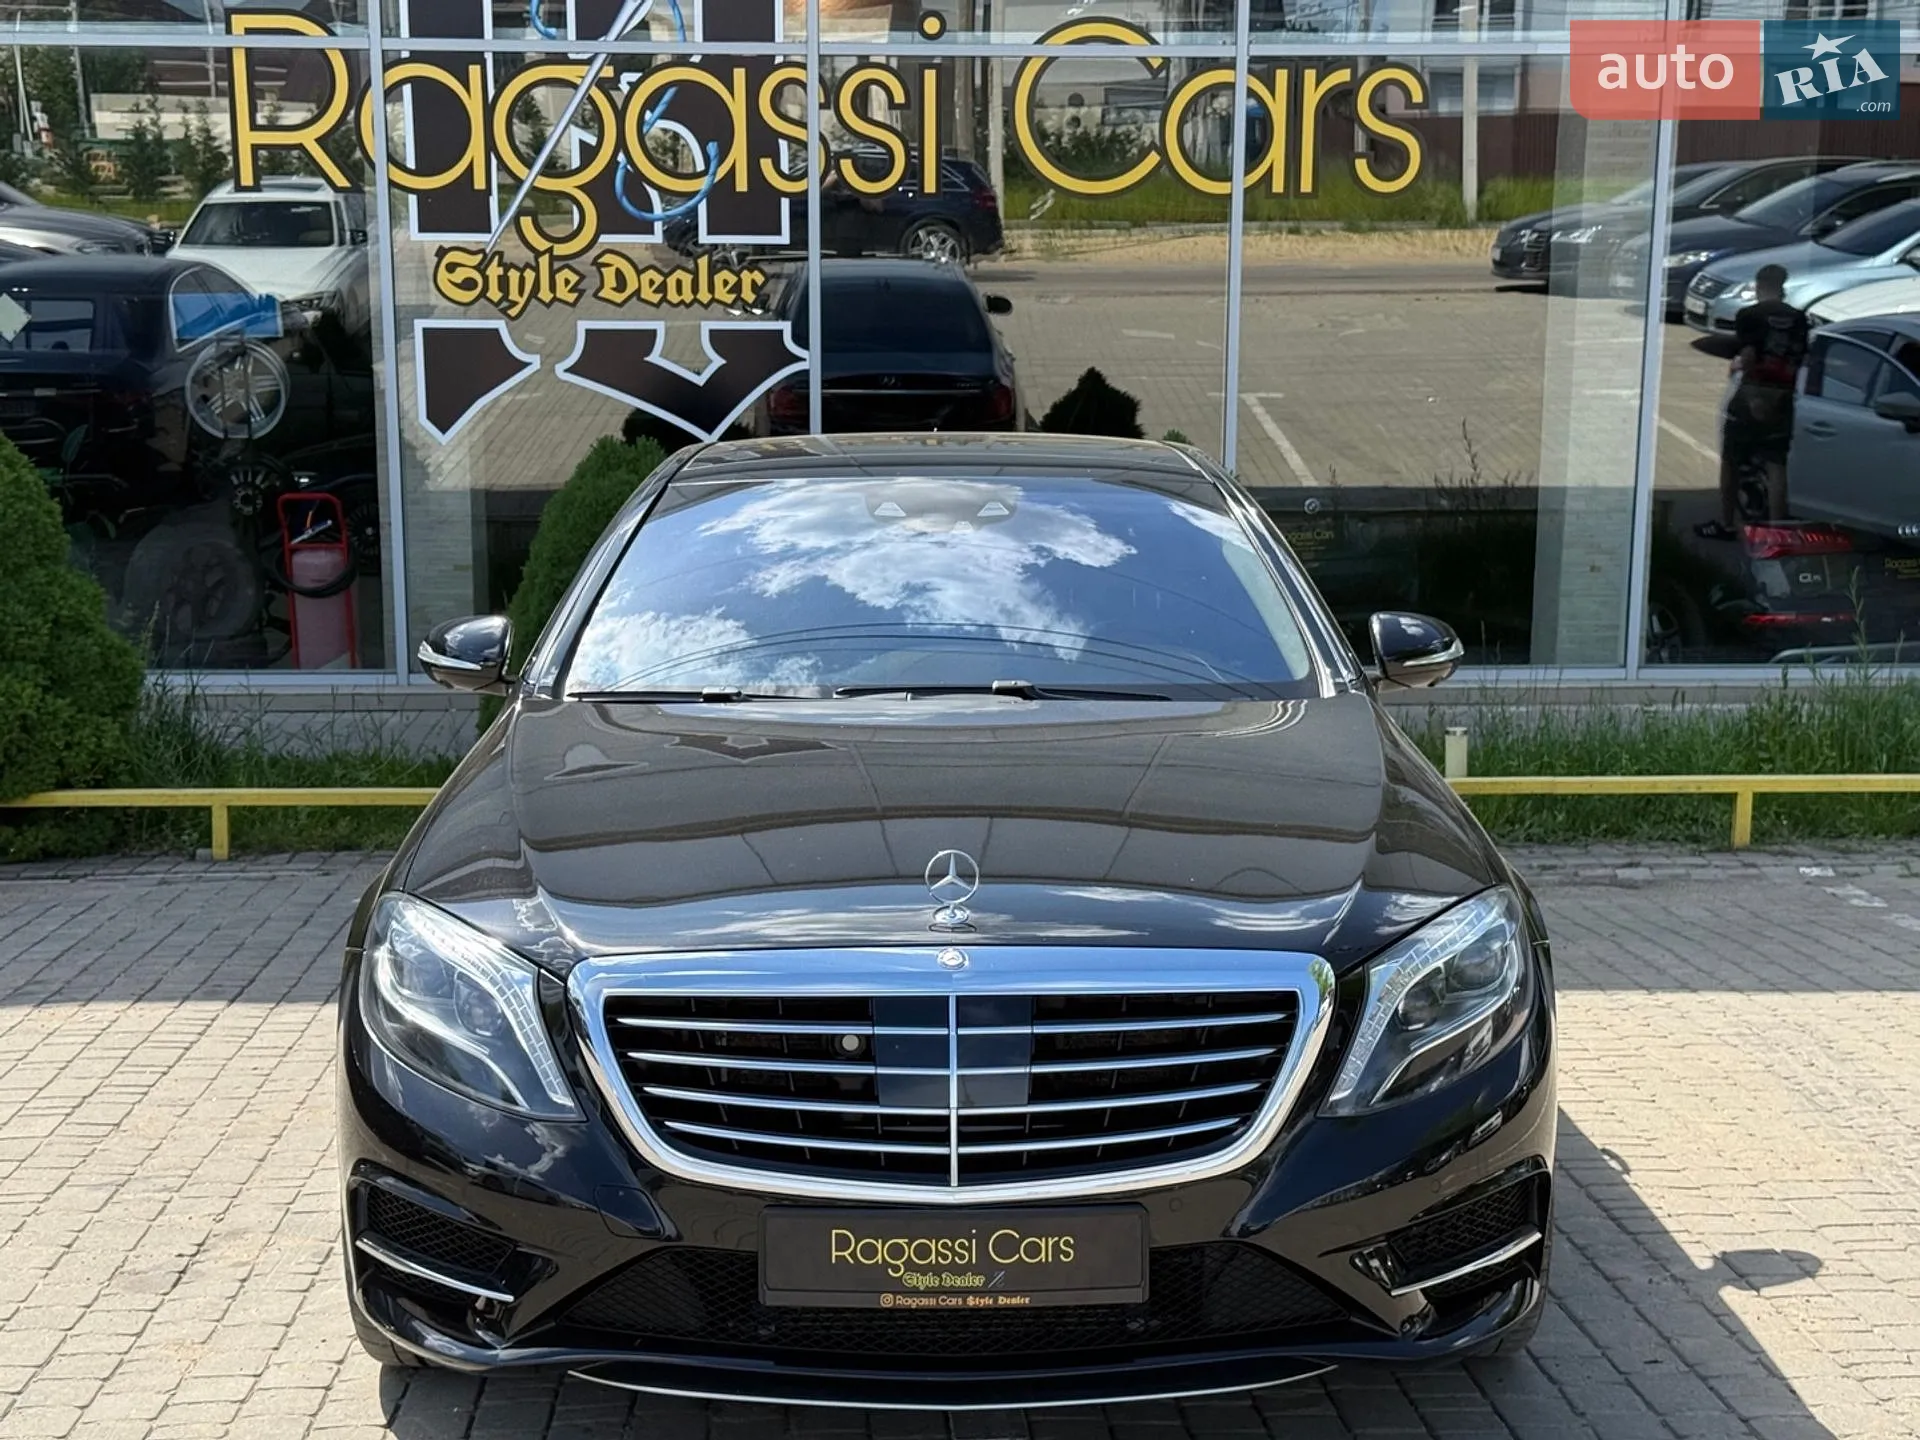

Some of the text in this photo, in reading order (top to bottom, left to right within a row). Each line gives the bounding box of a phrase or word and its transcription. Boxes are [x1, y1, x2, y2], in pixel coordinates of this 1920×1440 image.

[228, 12, 1426, 255] Ragassi Cars
[435, 247, 767, 319] Style Dealer
[831, 1229, 1075, 1277] Ragassi Cars
[895, 1296, 936, 1308] Ragassi
[938, 1296, 962, 1306] Cars
[902, 1272, 986, 1290] Style Dealer
